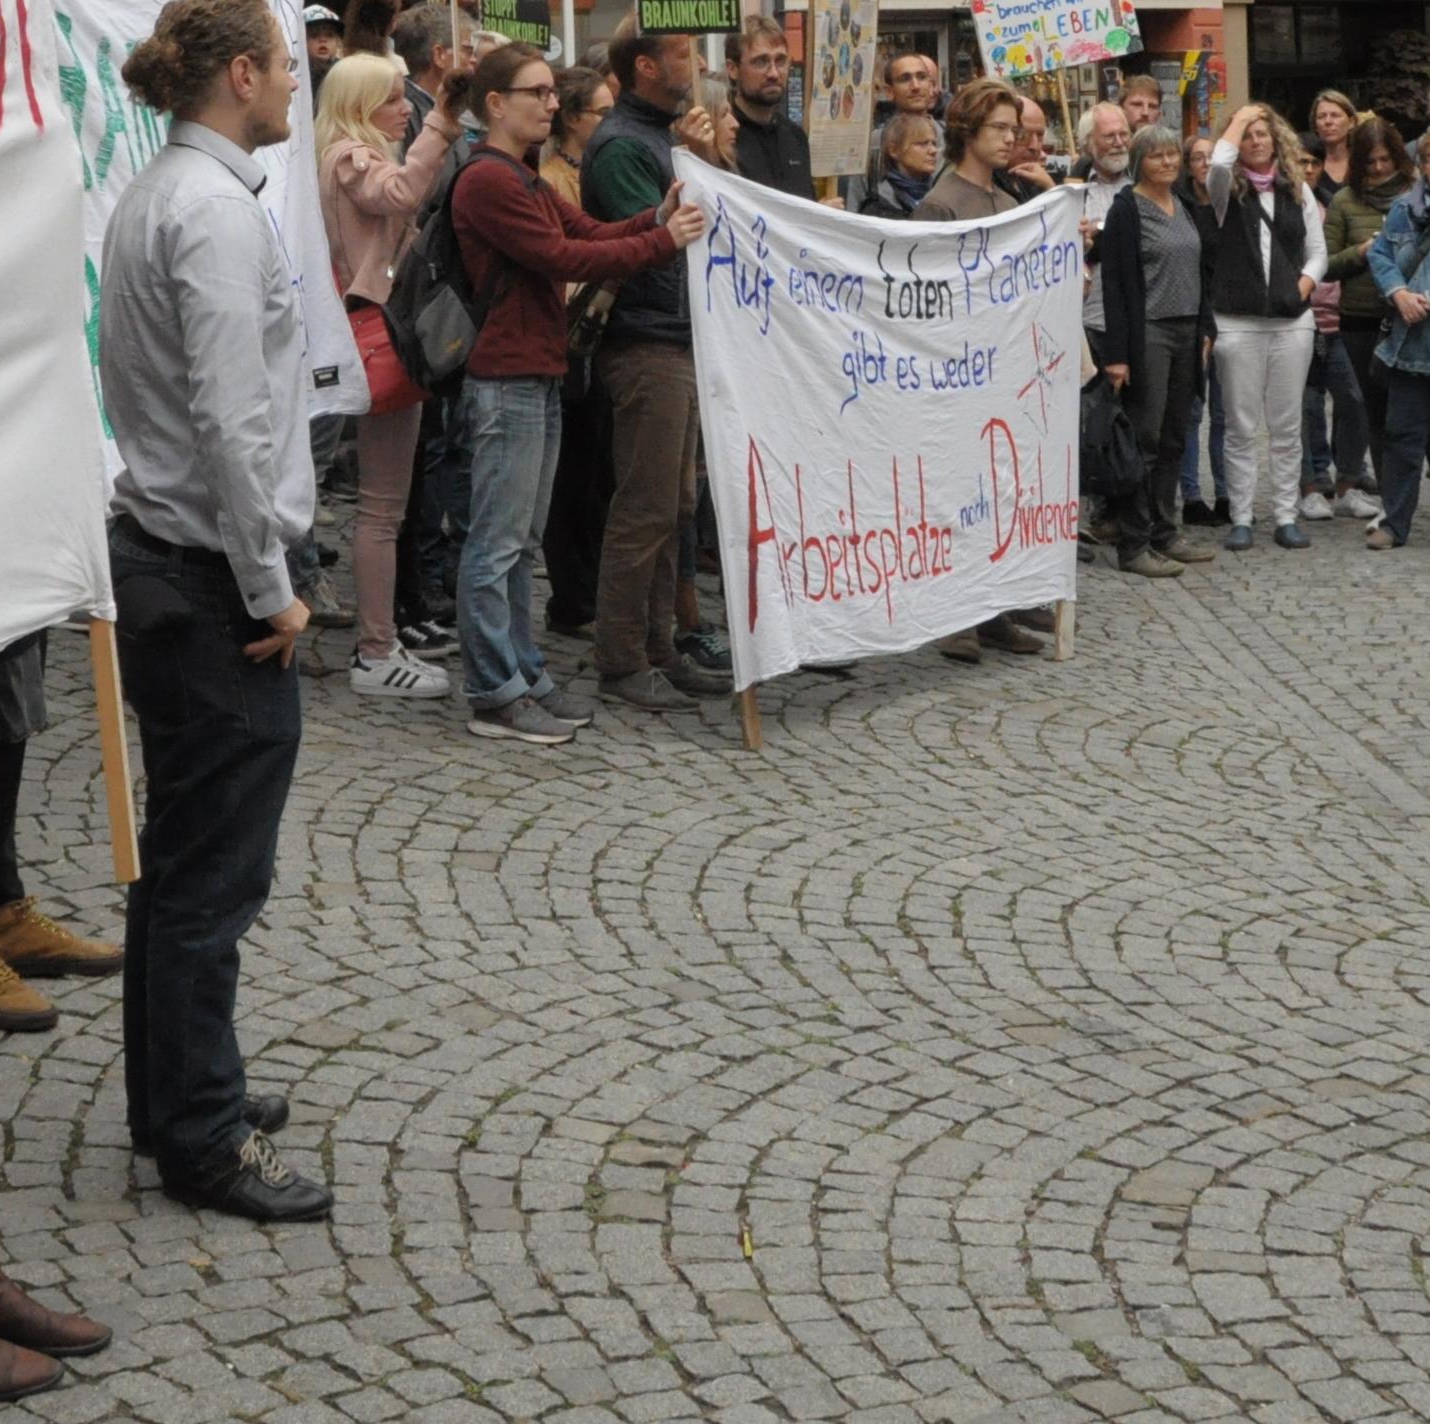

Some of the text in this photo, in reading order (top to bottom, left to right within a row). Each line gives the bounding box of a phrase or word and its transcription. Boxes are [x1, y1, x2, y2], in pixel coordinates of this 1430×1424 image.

[642, 0, 737, 29] BRAUNKOHLE!
[1001, 8, 1109, 41] zum LEBEN
[707, 194, 1079, 337] Auf einem toten Planeten
[840, 331, 997, 415] gibt es weder
[747, 433, 953, 635] Arbeitsplätze
[960, 472, 990, 531] noch
